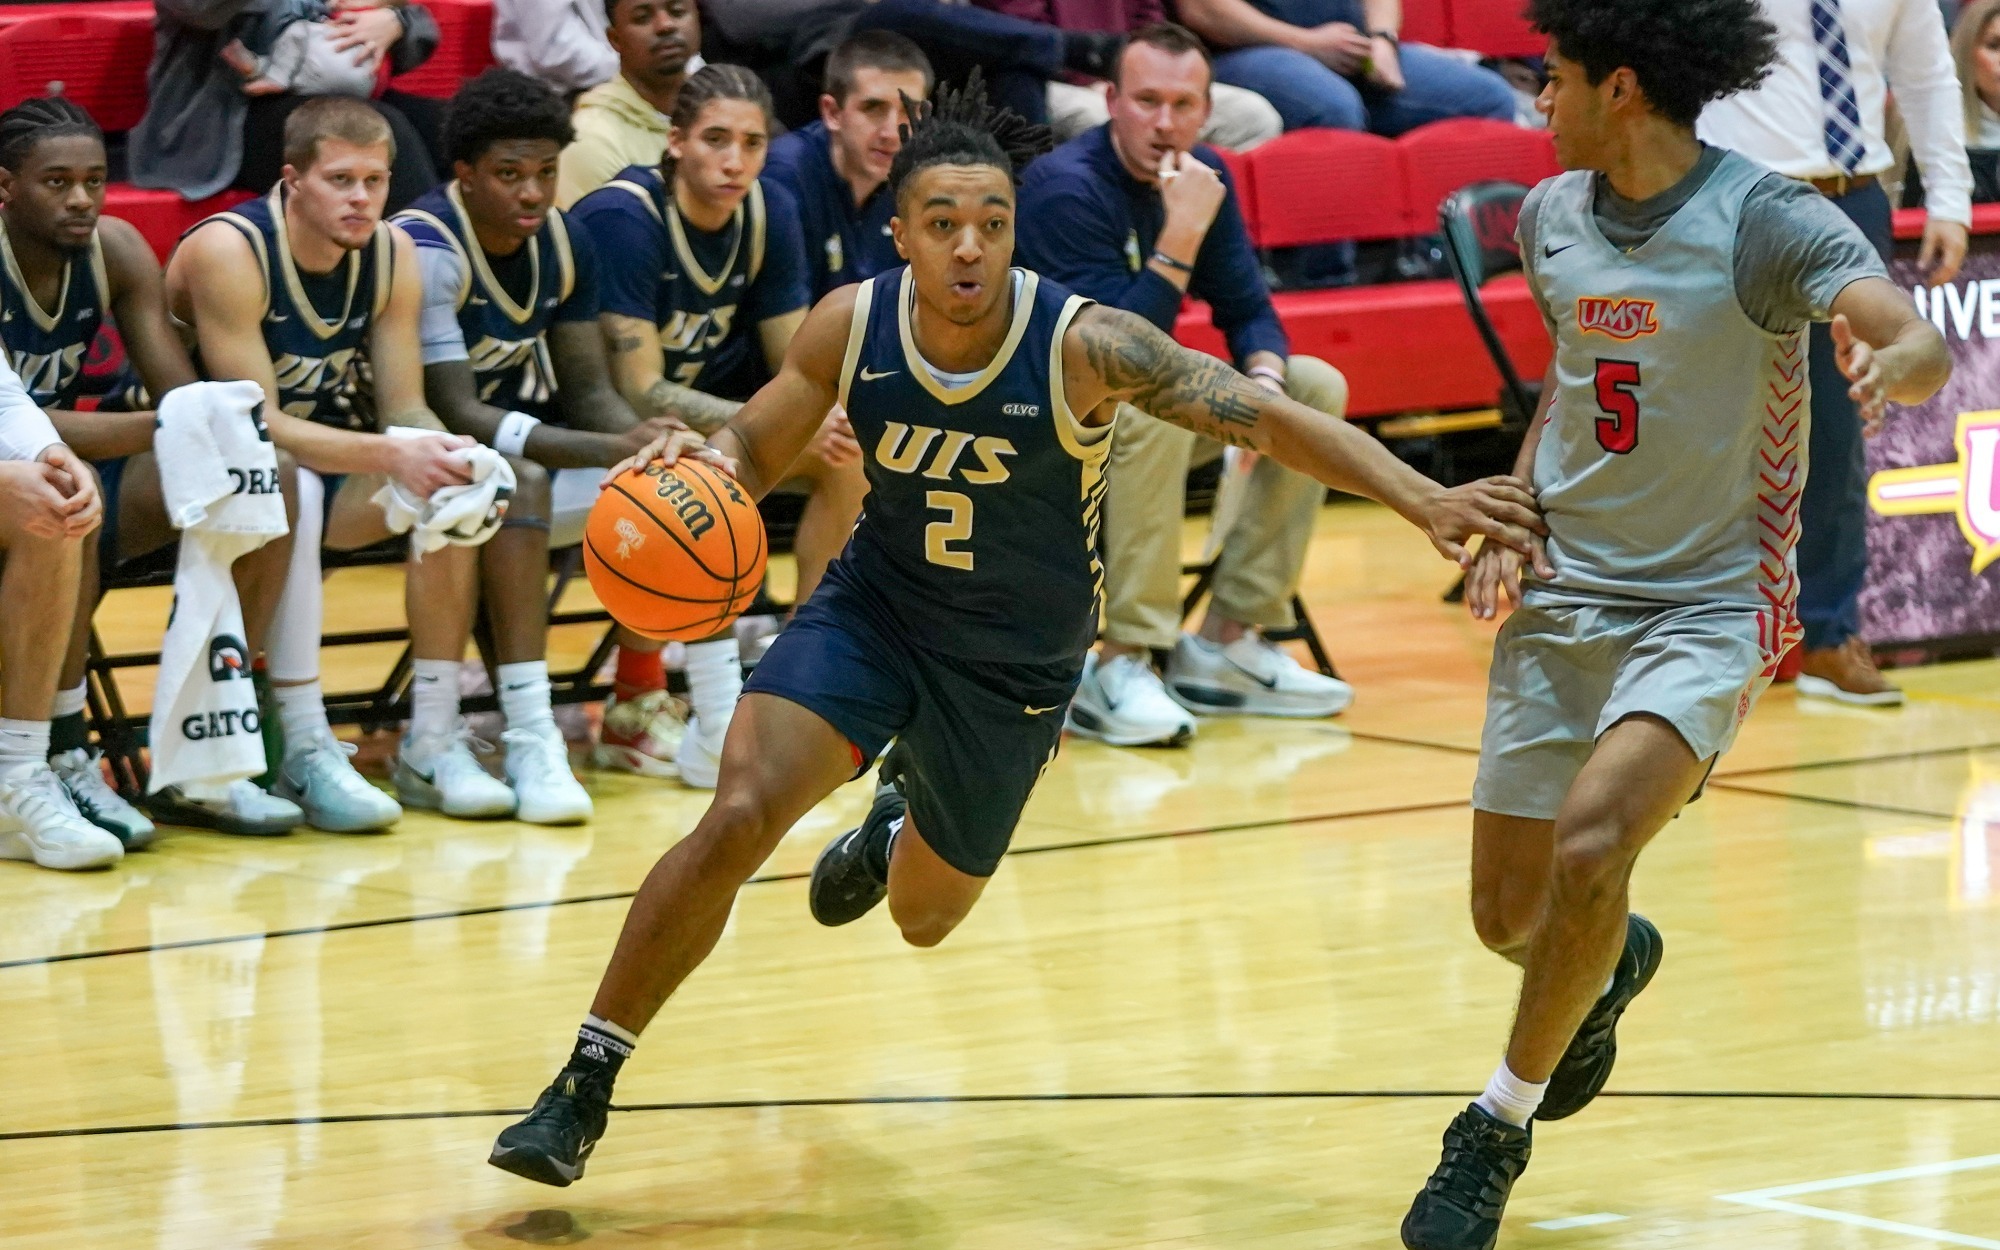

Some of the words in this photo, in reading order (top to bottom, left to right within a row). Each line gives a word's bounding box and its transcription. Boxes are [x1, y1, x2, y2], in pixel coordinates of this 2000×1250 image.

[660, 304, 737, 353] UIS
[1578, 298, 1658, 340] UMSL
[274, 347, 356, 394] UIS
[1002, 403, 1039, 418] GLVC
[1594, 358, 1640, 454] 5
[875, 421, 1018, 485] UIS
[644, 463, 716, 542] Wilso
[925, 490, 974, 572] 2
[182, 707, 262, 741] GATO
[581, 1047, 609, 1063] adidas
